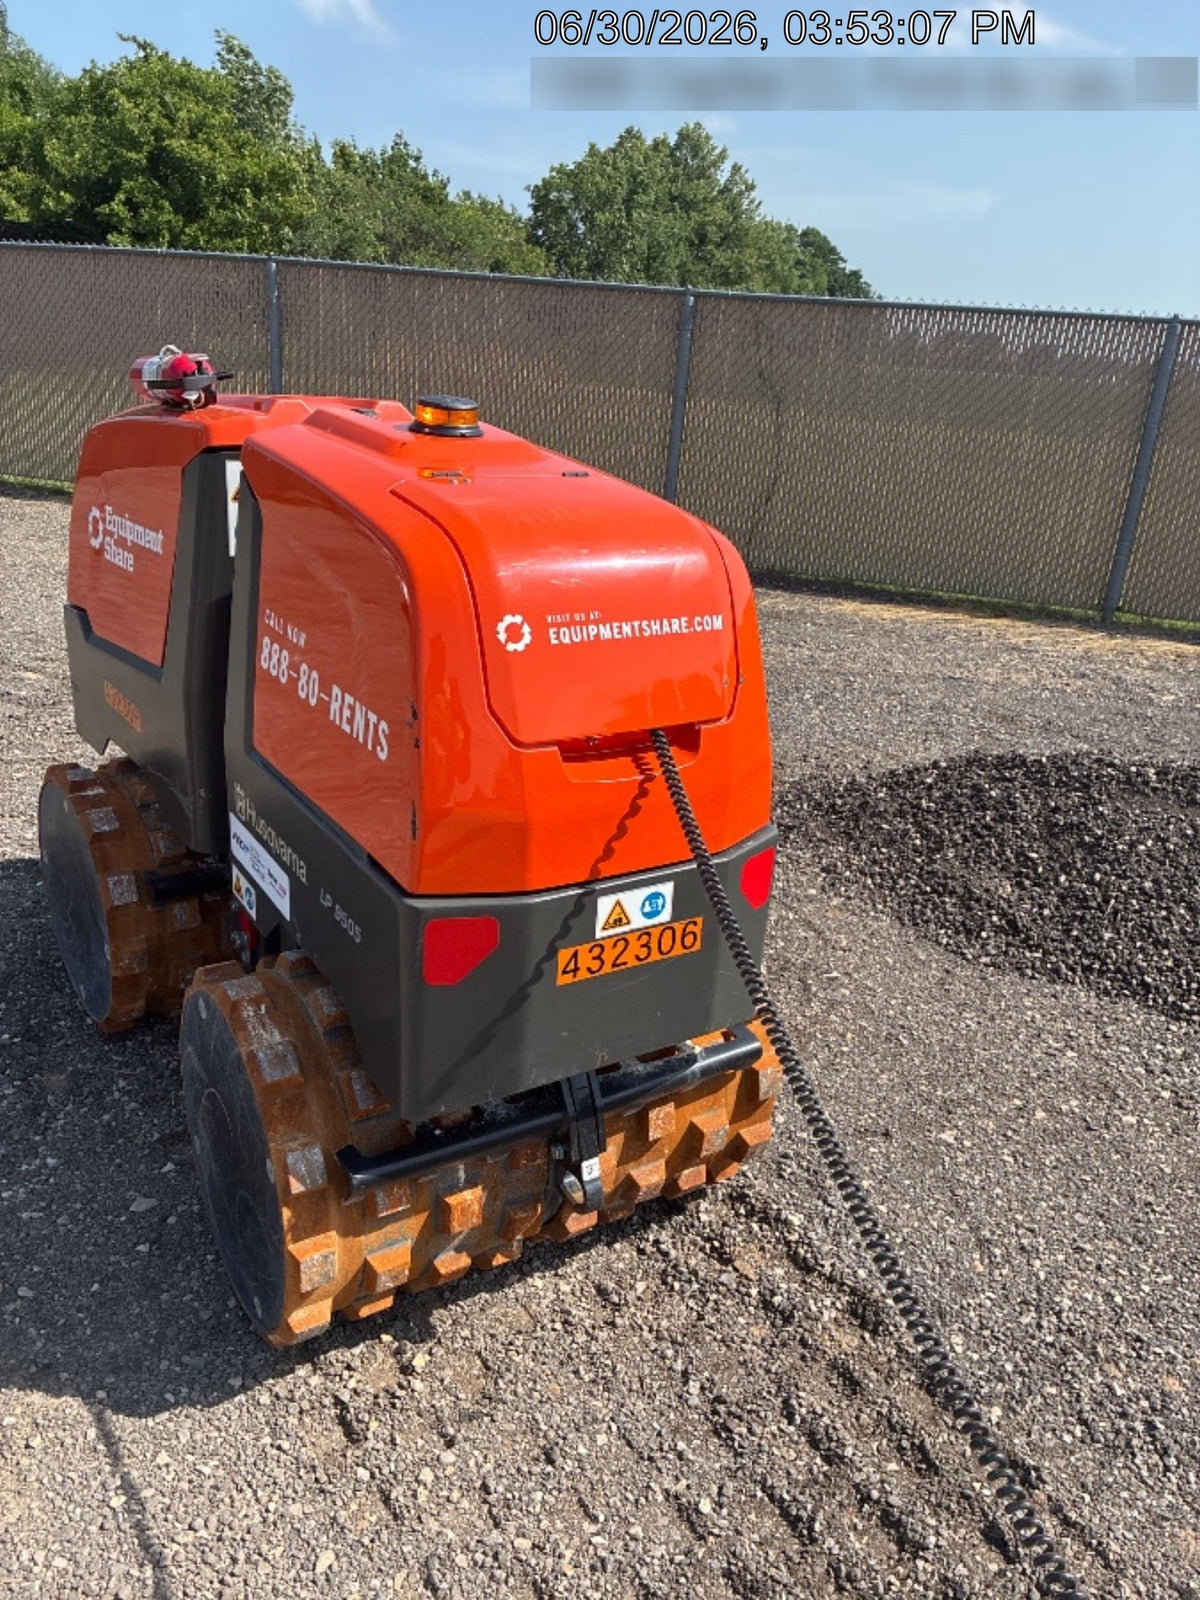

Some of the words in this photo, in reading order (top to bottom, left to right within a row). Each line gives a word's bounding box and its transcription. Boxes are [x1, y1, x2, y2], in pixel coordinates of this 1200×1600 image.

[104, 504, 164, 555] Equipment
[104, 536, 134, 572] Share
[264, 608, 284, 635] CALL
[287, 623, 306, 648] NOW
[548, 614, 724, 646] EQUIPMENTSHARE.COM
[573, 612, 586, 622] US
[260, 635, 390, 762] 888-80-RENTS
[246, 797, 308, 885] Husqvarna
[319, 887, 334, 908] LP
[561, 920, 699, 979] 432306
